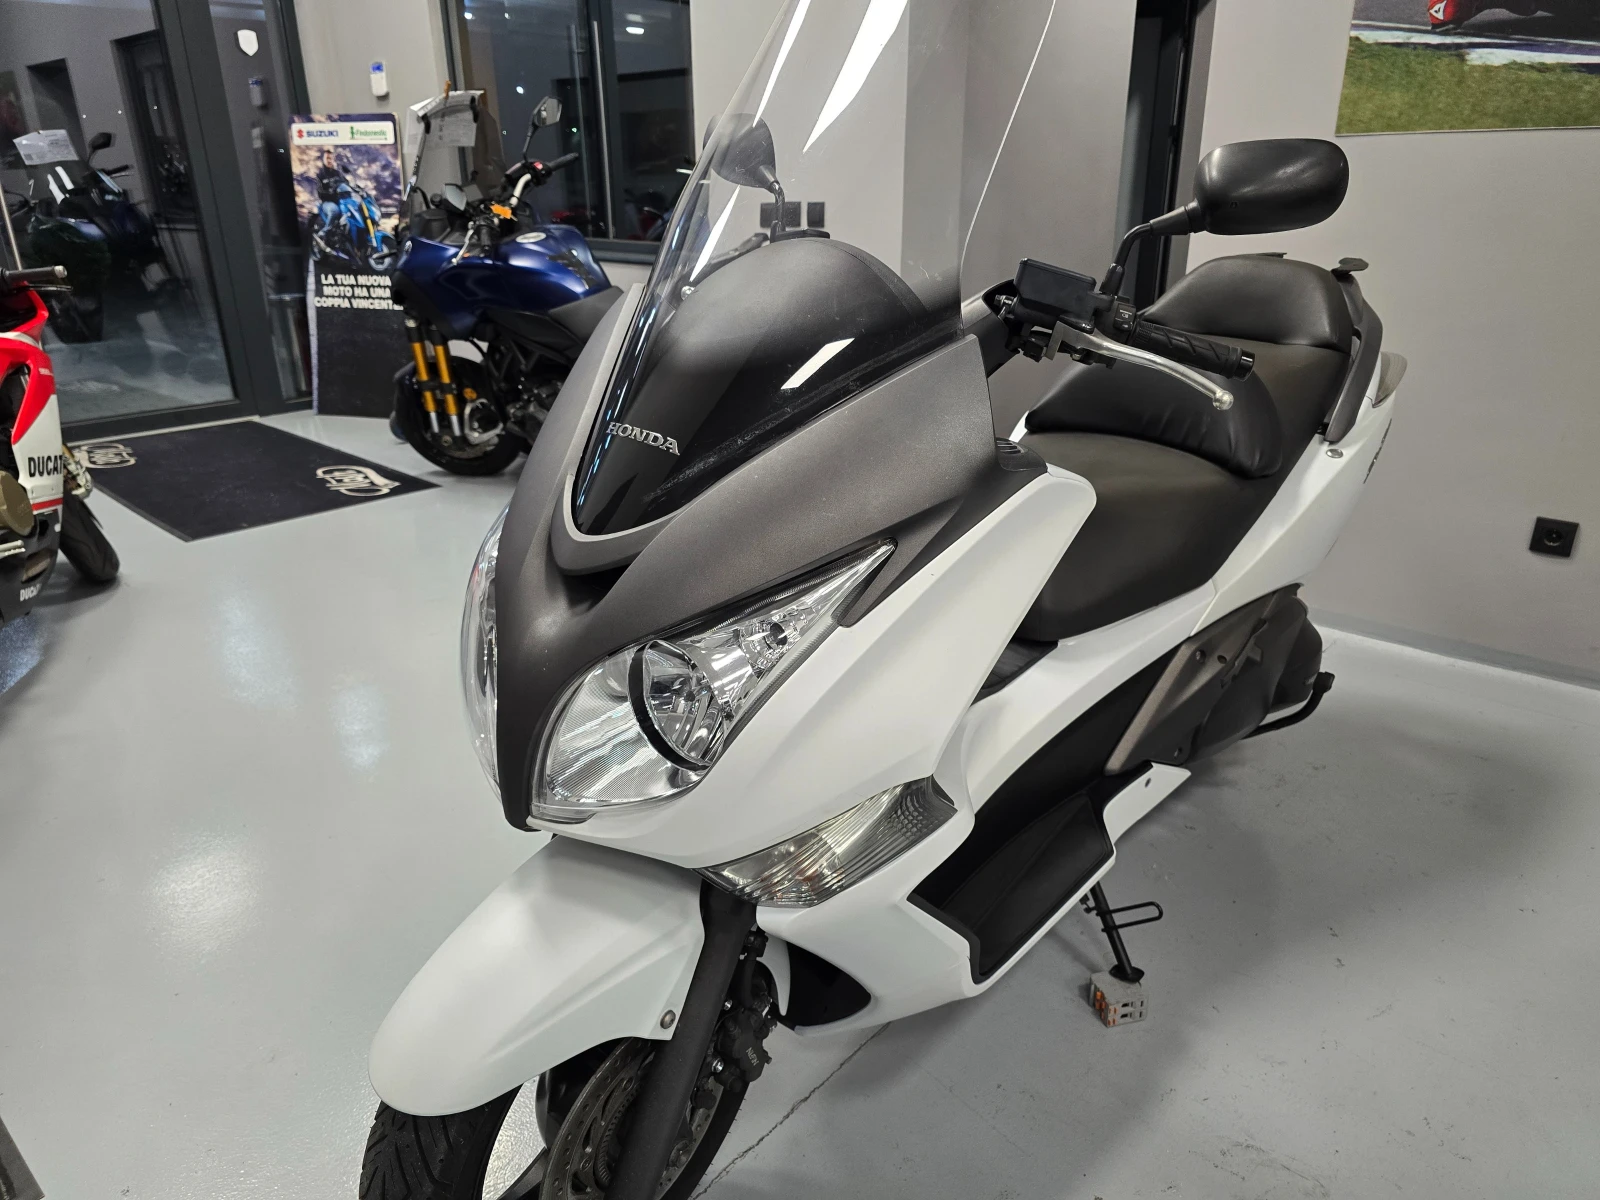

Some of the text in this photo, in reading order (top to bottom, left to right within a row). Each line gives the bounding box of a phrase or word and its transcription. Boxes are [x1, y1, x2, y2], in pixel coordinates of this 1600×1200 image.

[306, 130, 339, 138] SUZUKI
[320, 273, 392, 286] LA TUA NUOVA
[323, 286, 391, 298] MOTO HA UNA
[314, 296, 351, 308] COPPIA
[606, 421, 680, 456] HONDA
